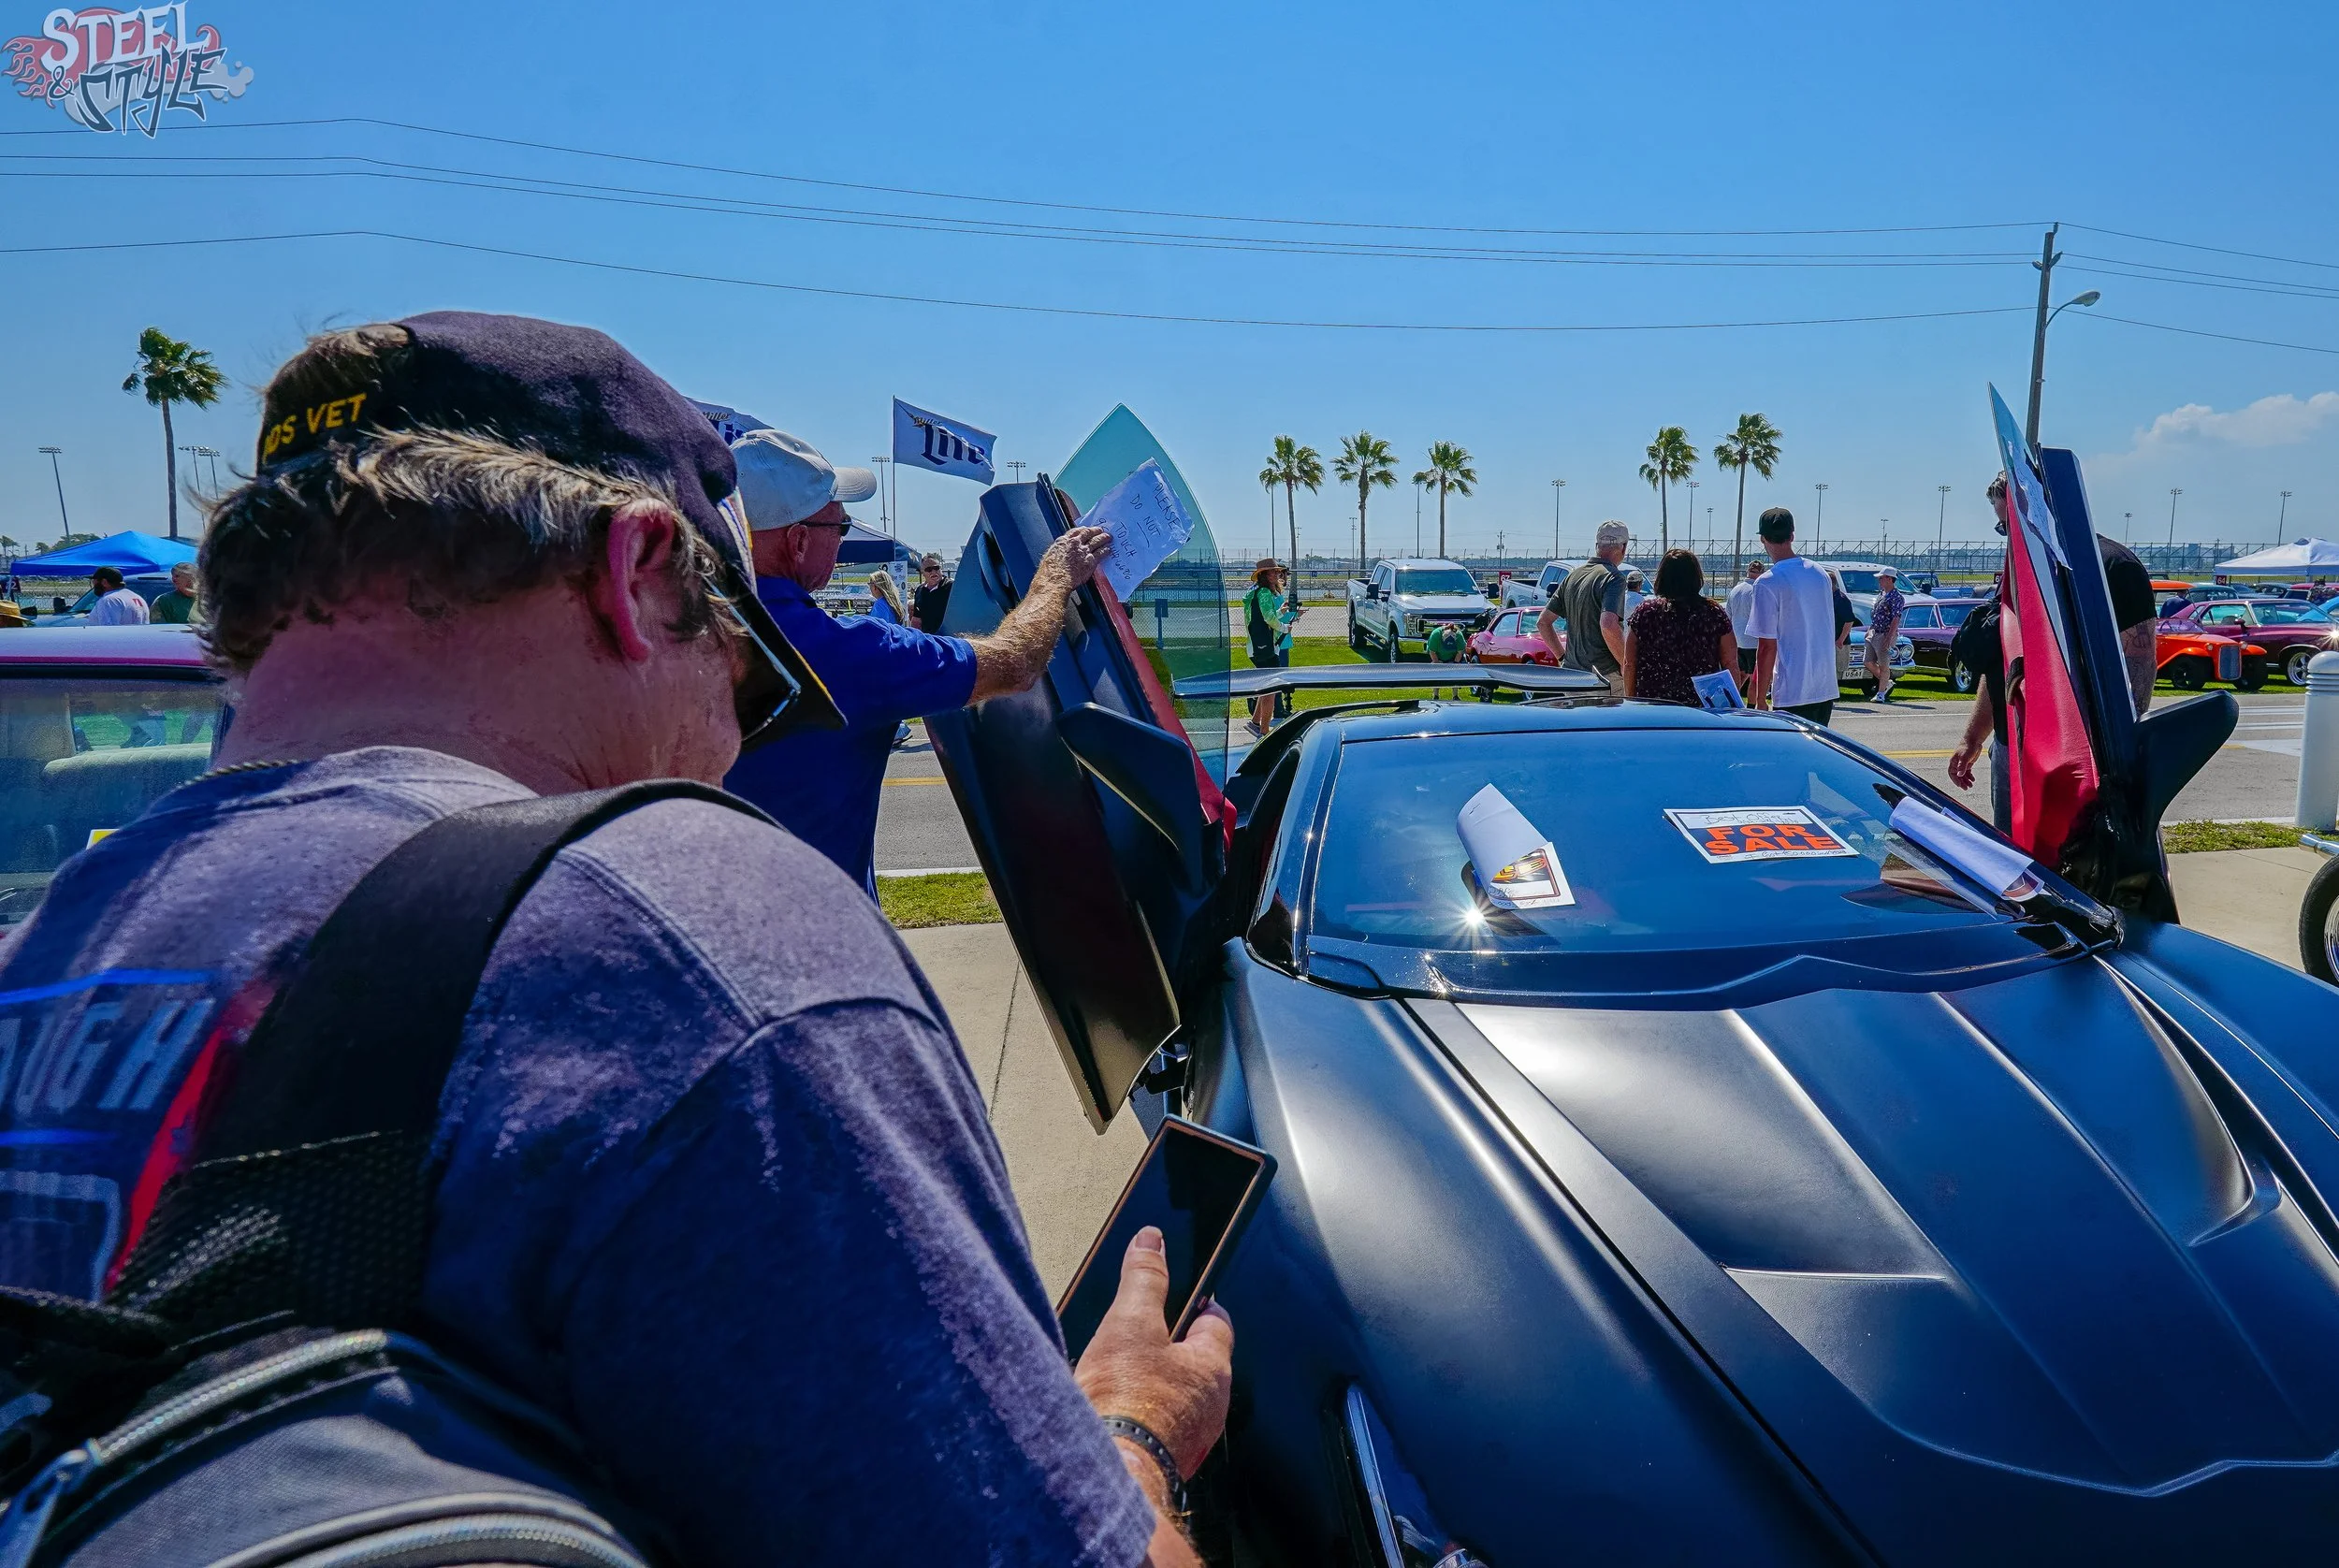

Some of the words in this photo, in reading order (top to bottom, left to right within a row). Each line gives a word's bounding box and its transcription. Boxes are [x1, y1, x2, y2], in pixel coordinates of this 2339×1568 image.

[306, 392, 368, 434] VET
[920, 423, 985, 466] Lite
[1129, 493, 1143, 510] DO
[1152, 482, 1181, 530] PLEASE
[1114, 521, 1138, 558] TOUCH
[2216, 576, 2227, 585] 64
[1705, 836, 1841, 855] SALE
[1707, 824, 1807, 841] FOR
